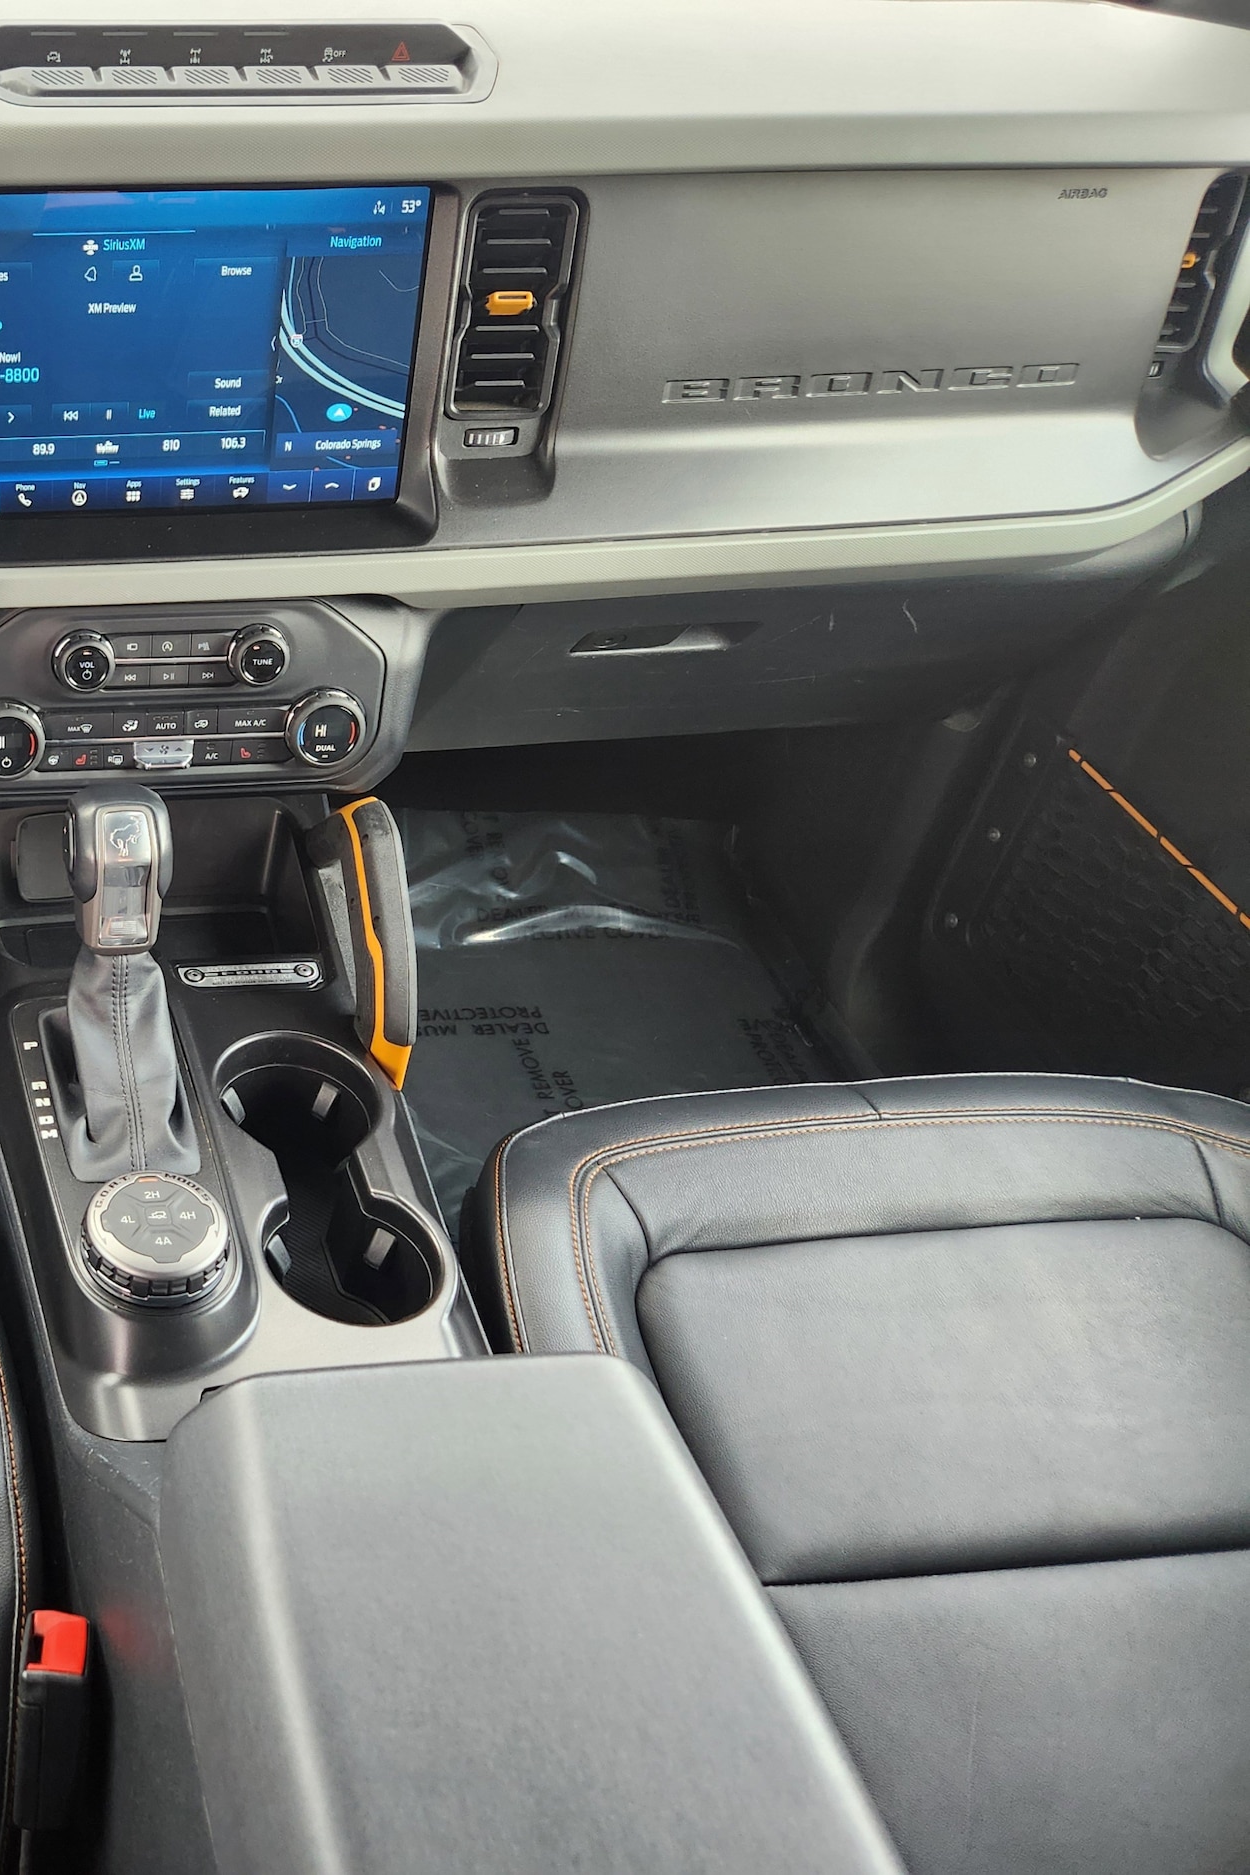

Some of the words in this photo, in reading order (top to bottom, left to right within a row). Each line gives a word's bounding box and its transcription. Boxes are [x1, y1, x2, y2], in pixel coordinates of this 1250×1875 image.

[333, 50, 346, 58] OFF
[1058, 187, 1108, 200] AIRBAG
[401, 200, 422, 214] 53°
[103, 238, 146, 251] SiriusXM
[330, 236, 382, 249] Navigation
[221, 265, 252, 276] Browse
[88, 303, 102, 314] XM
[103, 302, 136, 314] Preview
[0, 352, 21, 363] Now!
[214, 377, 242, 389] Sound
[661, 363, 1080, 404] BRONCO
[138, 408, 156, 420] Live
[209, 406, 241, 417] Related
[32, 443, 55, 456] 89.9
[162, 439, 180, 452] 810
[221, 437, 246, 449] 106.3
[284, 442, 292, 451] N
[315, 440, 351, 451] Colorado
[351, 439, 381, 450] Springs
[73, 481, 86, 489] Nav
[126, 480, 142, 489] Apps
[176, 478, 200, 487] Settings
[229, 476, 254, 484] Features
[15, 483, 35, 491] Phone
[79, 661, 95, 669] VOL
[252, 658, 273, 666] TUNE
[155, 722, 177, 730] AUTO
[253, 719, 267, 727] A/C
[315, 725, 327, 738] HI
[315, 744, 336, 752] DUAL
[205, 752, 219, 760] A/C
[418, 1006, 543, 1021] PROTECTIVE
[471, 1022, 550, 1036] DEALER
[23, 1041, 39, 1050] P
[511, 1037, 556, 1101] REMOVE
[31, 1081, 47, 1091] R
[35, 1097, 51, 1107] N
[38, 1115, 54, 1125] D
[41, 1129, 58, 1139] M
[164, 1173, 211, 1202] MODES
[144, 1190, 160, 1199] 2H
[120, 1215, 135, 1224] 4L
[179, 1211, 197, 1220] 4H
[155, 1236, 172, 1245] 4A
